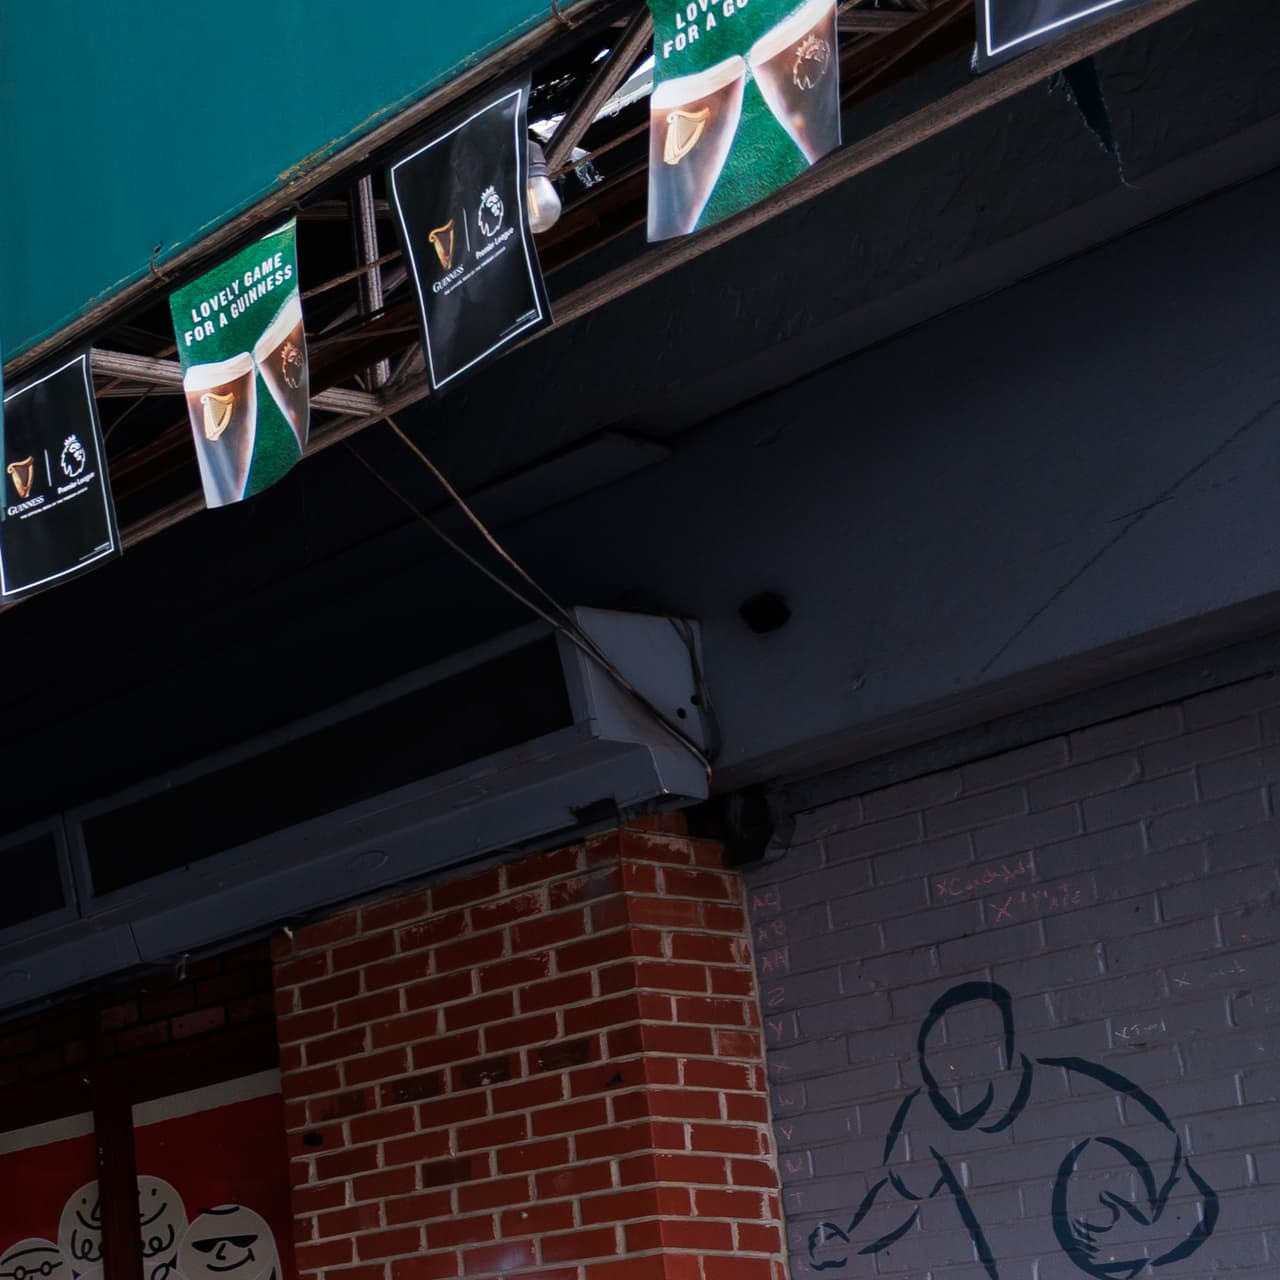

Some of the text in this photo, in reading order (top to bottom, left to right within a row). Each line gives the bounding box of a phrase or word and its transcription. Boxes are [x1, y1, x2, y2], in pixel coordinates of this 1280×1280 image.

[663, 11, 717, 59] FOR A
[191, 252, 283, 323] LOVELY GAME
[432, 264, 464, 293] GUINNESS
[184, 265, 293, 347] FOR A GUINNESS
[7, 496, 44, 516] GUINNESS
